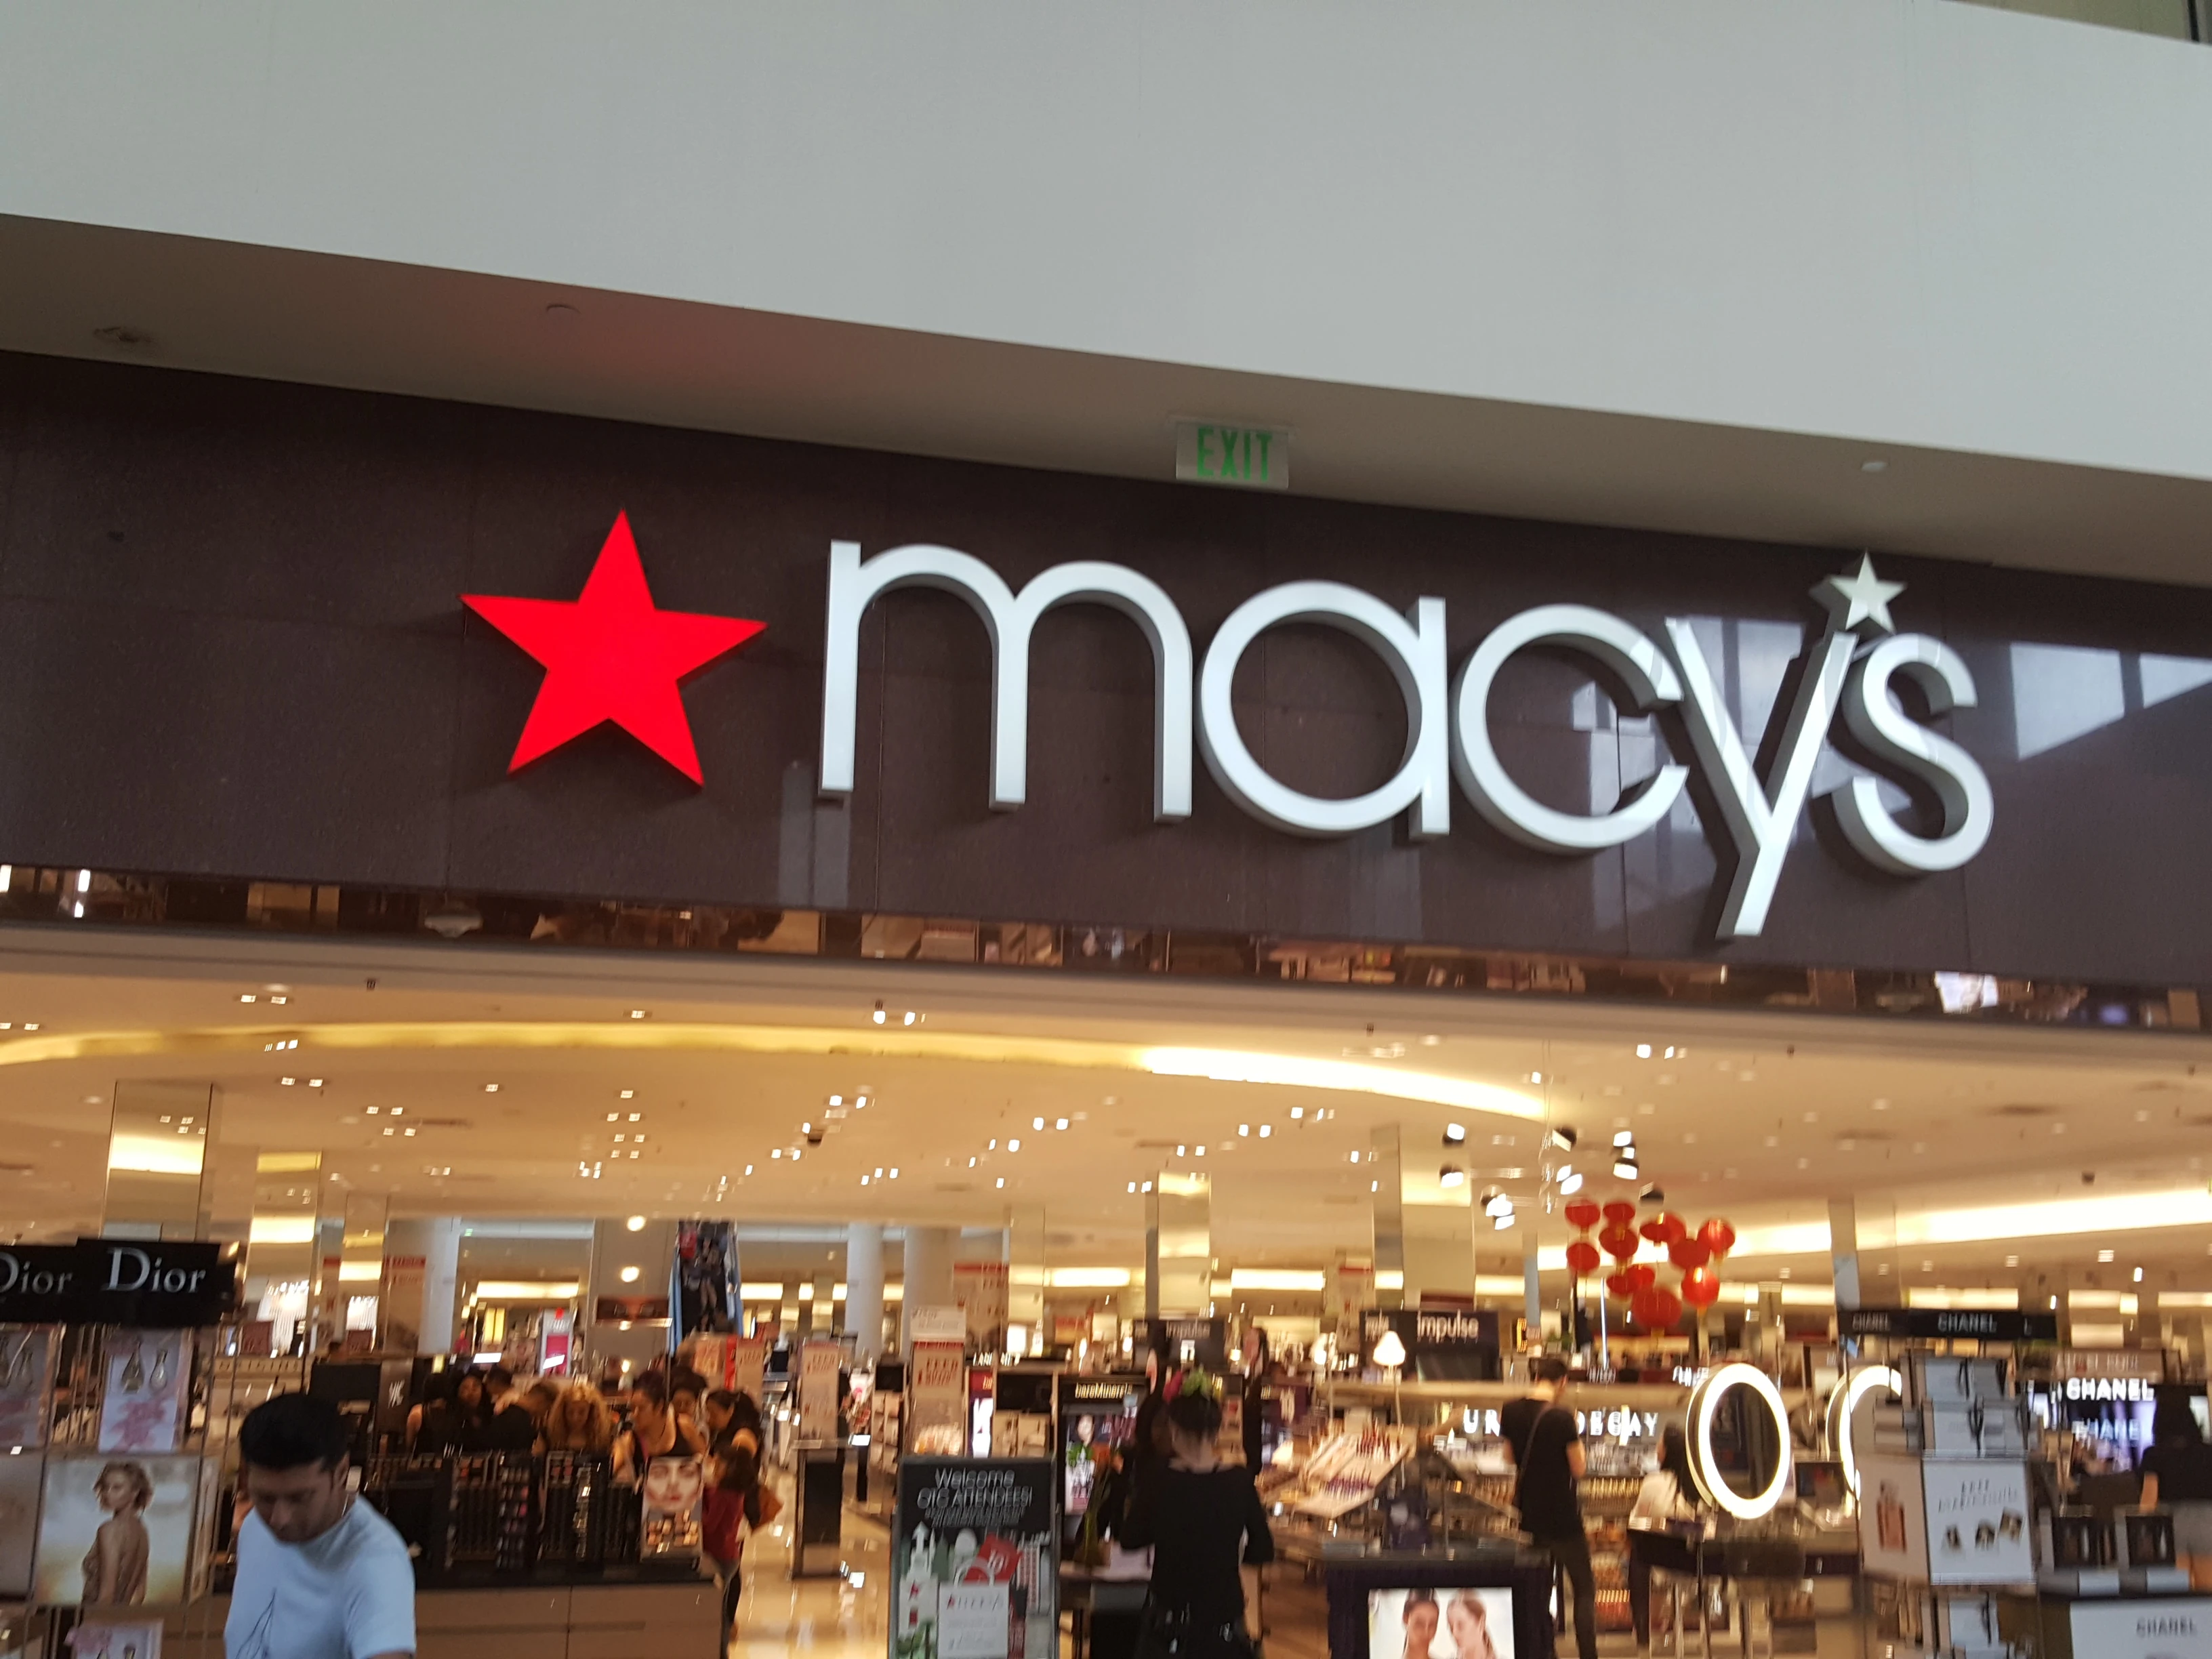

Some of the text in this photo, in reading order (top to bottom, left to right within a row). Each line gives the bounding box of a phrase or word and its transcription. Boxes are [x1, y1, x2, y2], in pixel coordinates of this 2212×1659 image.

[1197, 425, 1273, 481] EXIT
[102, 1246, 206, 1294] Dior
[1938, 1312, 1996, 1333] CHANEL
[2067, 1377, 2154, 1401] CHANEL
[935, 1467, 1015, 1490] Welcome
[2136, 1616, 2197, 1638] CHANEL
